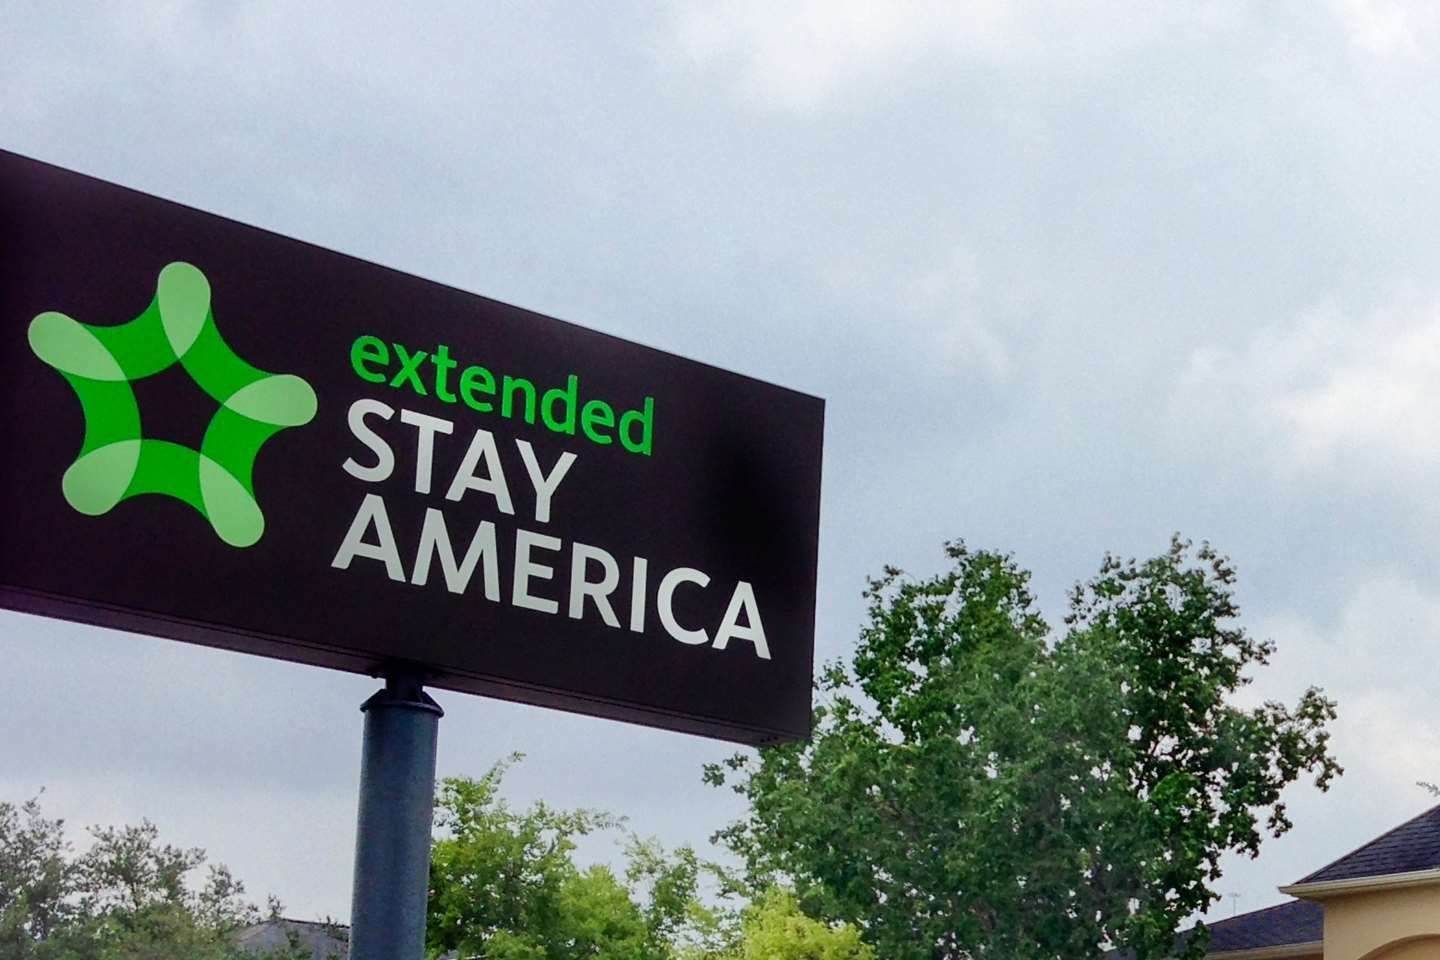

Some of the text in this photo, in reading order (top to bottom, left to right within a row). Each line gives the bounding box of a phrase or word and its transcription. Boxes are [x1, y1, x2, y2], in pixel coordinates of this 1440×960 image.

[350, 334, 655, 456] extended
[341, 398, 578, 525] STAY
[330, 493, 773, 661] AMERICA
